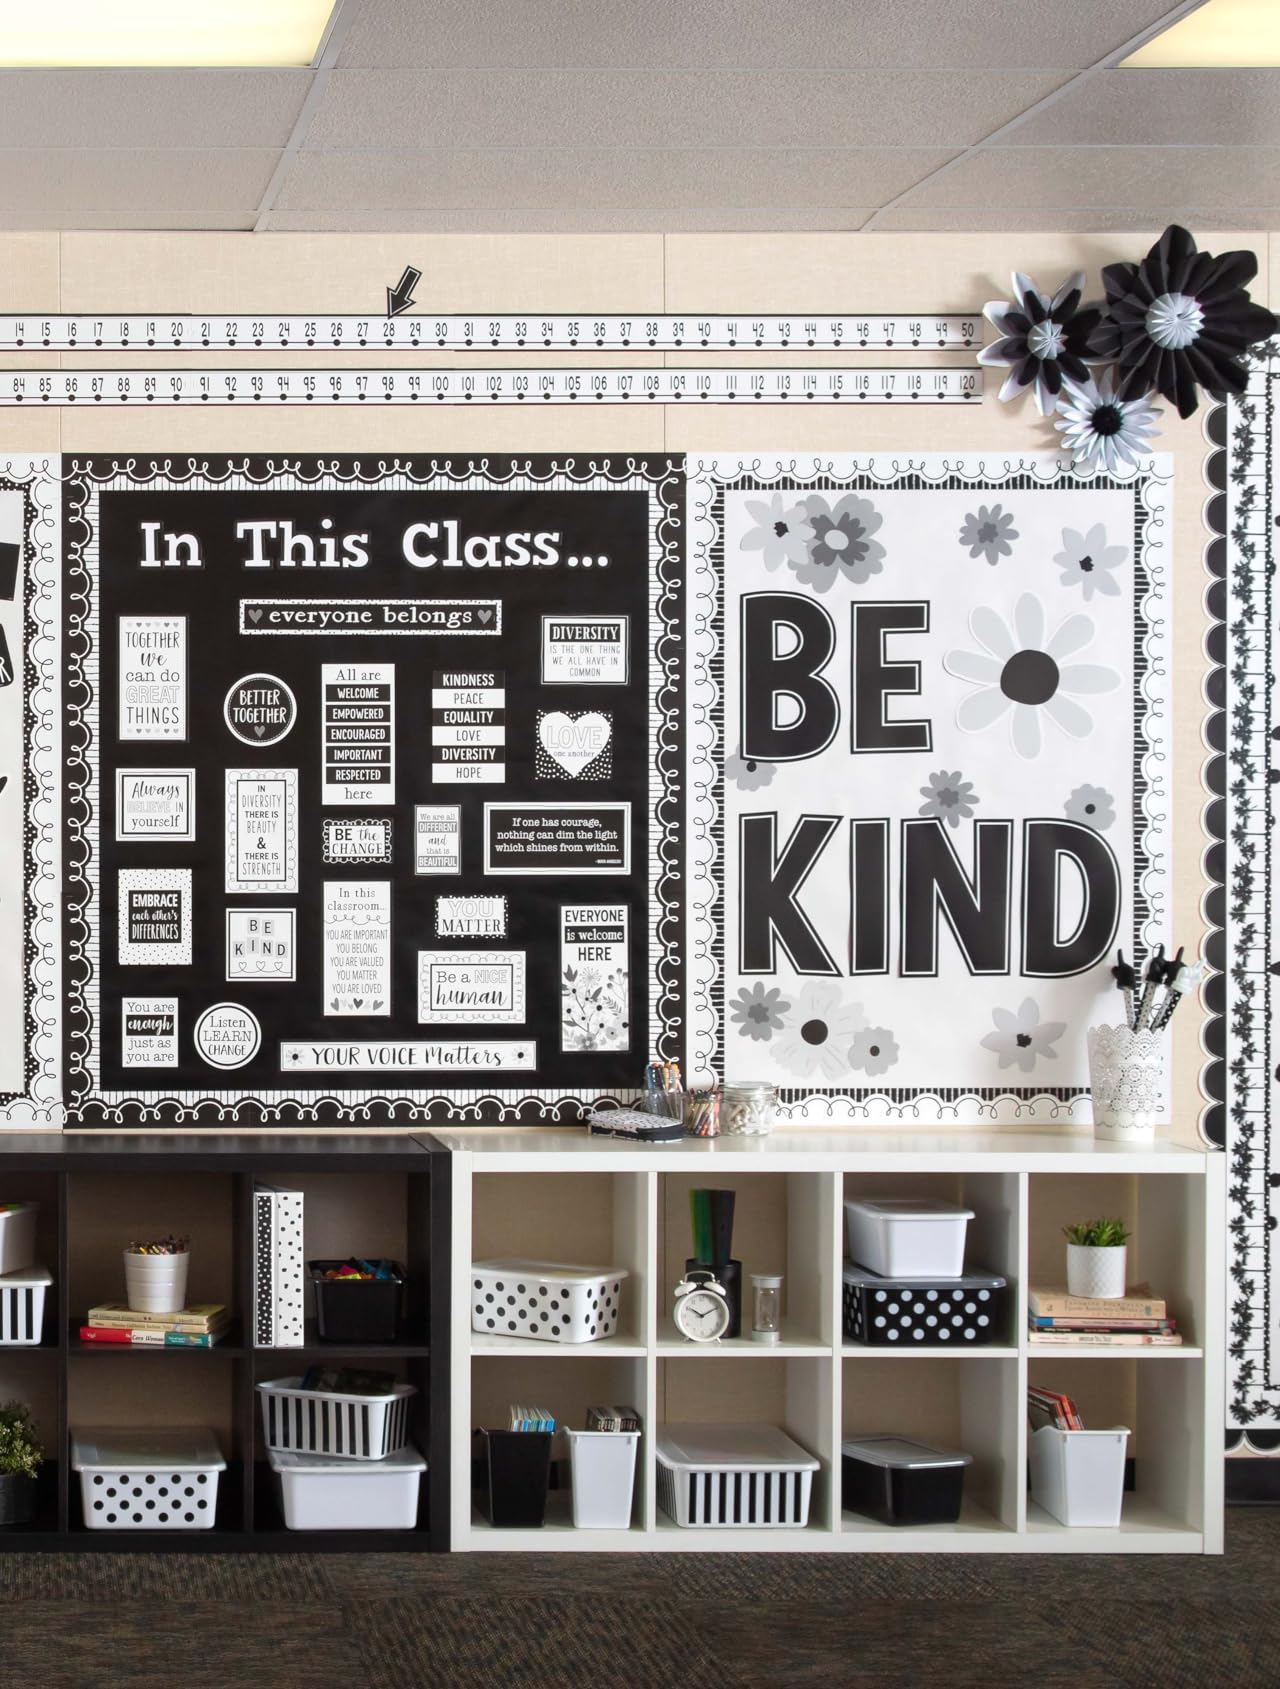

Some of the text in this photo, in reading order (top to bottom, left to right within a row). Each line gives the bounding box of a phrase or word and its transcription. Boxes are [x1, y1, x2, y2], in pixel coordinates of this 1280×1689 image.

[279, 323, 290, 337] 24
[331, 323, 343, 337] 26
[435, 323, 448, 336] 30
[962, 323, 974, 337] 50
[432, 376, 449, 390] 100
[959, 375, 975, 389] 120
[139, 518, 609, 569] In This Class...
[268, 605, 473, 626] everyone belongs
[126, 632, 180, 648] TOGETHER
[141, 652, 168, 667] we
[126, 670, 180, 682] can do
[336, 669, 381, 680] All are
[443, 674, 494, 686] KINDNESS
[739, 590, 933, 763] BE
[126, 686, 180, 703] GREAT
[239, 689, 280, 705] BETTER
[337, 687, 379, 699] WELCOME
[454, 693, 484, 704] PEACE
[126, 707, 179, 724] THINGS
[233, 708, 287, 723] TOGETHER
[332, 708, 384, 720] EMPOWERED
[444, 711, 494, 724] EQUALITY
[331, 729, 385, 740] ENCOURAGED
[456, 730, 481, 741] LOVE
[334, 749, 383, 760] IMPORTANT
[442, 748, 496, 760] DIVERSITY
[336, 769, 381, 781] RESPECTED
[456, 767, 481, 778] HOPE
[345, 787, 373, 800] here
[512, 818, 521, 826] If
[542, 818, 559, 826] has
[561, 819, 602, 828] courage,
[335, 827, 378, 841] BE the
[332, 843, 383, 854] CHANGE
[495, 843, 619, 852] which shines from within.
[132, 893, 178, 907] EMBRACE
[738, 811, 1122, 978] KIND
[132, 909, 177, 921] each other's
[565, 910, 624, 922] EVERYONE
[132, 924, 178, 940] DIFFERENCES
[442, 919, 501, 932] MATTER
[567, 928, 623, 941] is welcome
[578, 947, 612, 961] HERE
[203, 1031, 252, 1042] LEARN
[312, 1046, 504, 1066] YOUR VOICE Matters
